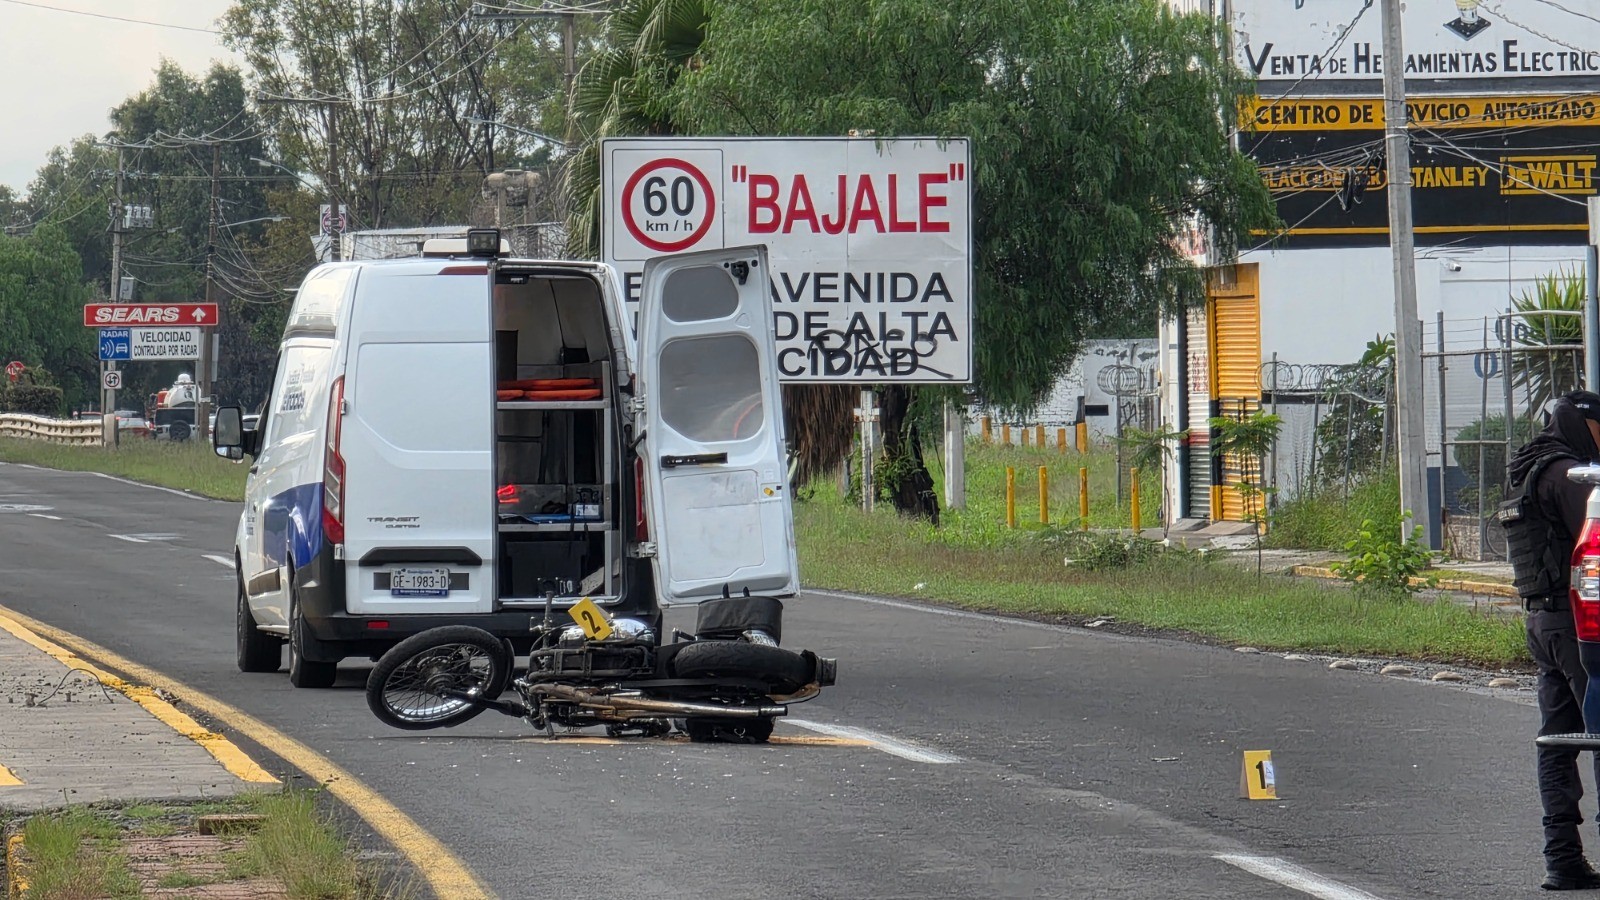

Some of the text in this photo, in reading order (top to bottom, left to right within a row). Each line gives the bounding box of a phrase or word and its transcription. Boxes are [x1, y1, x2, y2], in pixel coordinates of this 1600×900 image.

[1245, 43, 1322, 75] VENTA
[1330, 58, 1347, 74] DE
[1354, 43, 1497, 74] HEAMIENTAS
[1255, 101, 1595, 124] CENTRO DE RVICIO AUTORIZADO
[643, 175, 695, 217] 60
[623, 272, 642, 303] E
[94, 307, 180, 323] SEARS
[775, 311, 959, 342] DE ALTA
[101, 330, 129, 338] RADAR
[140, 331, 192, 343] VELOCIDAD
[134, 345, 198, 356] CONTROLADA POR RADAR
[777, 346, 919, 377] CIDAD
[393, 575, 447, 588] GE-1983-D
[581, 610, 601, 634] 2
[1255, 760, 1267, 789] 1
